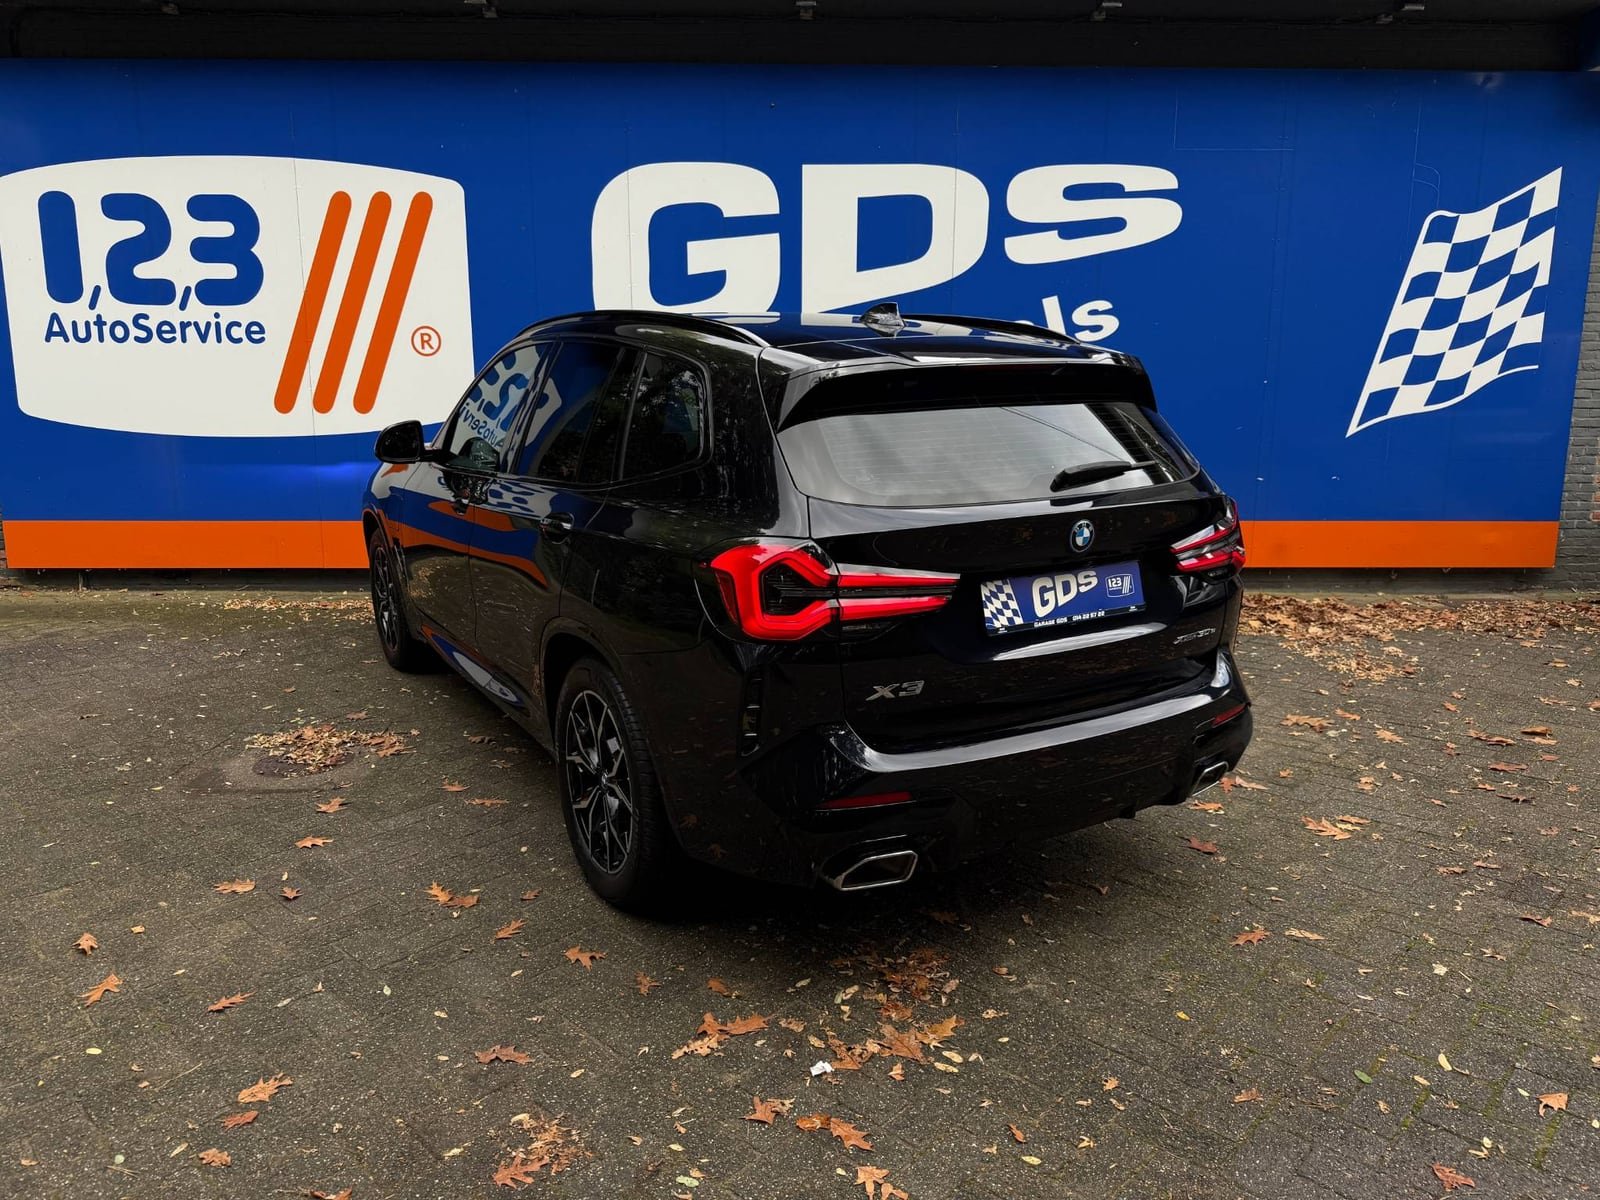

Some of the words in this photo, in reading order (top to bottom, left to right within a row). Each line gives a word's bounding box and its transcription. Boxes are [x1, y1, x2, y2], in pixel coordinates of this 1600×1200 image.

[591, 161, 1183, 314] GDS
[44, 311, 266, 344] AutoService
[1014, 295, 1119, 342] ls
[1031, 570, 1098, 618] GDS
[865, 680, 925, 701] X3
